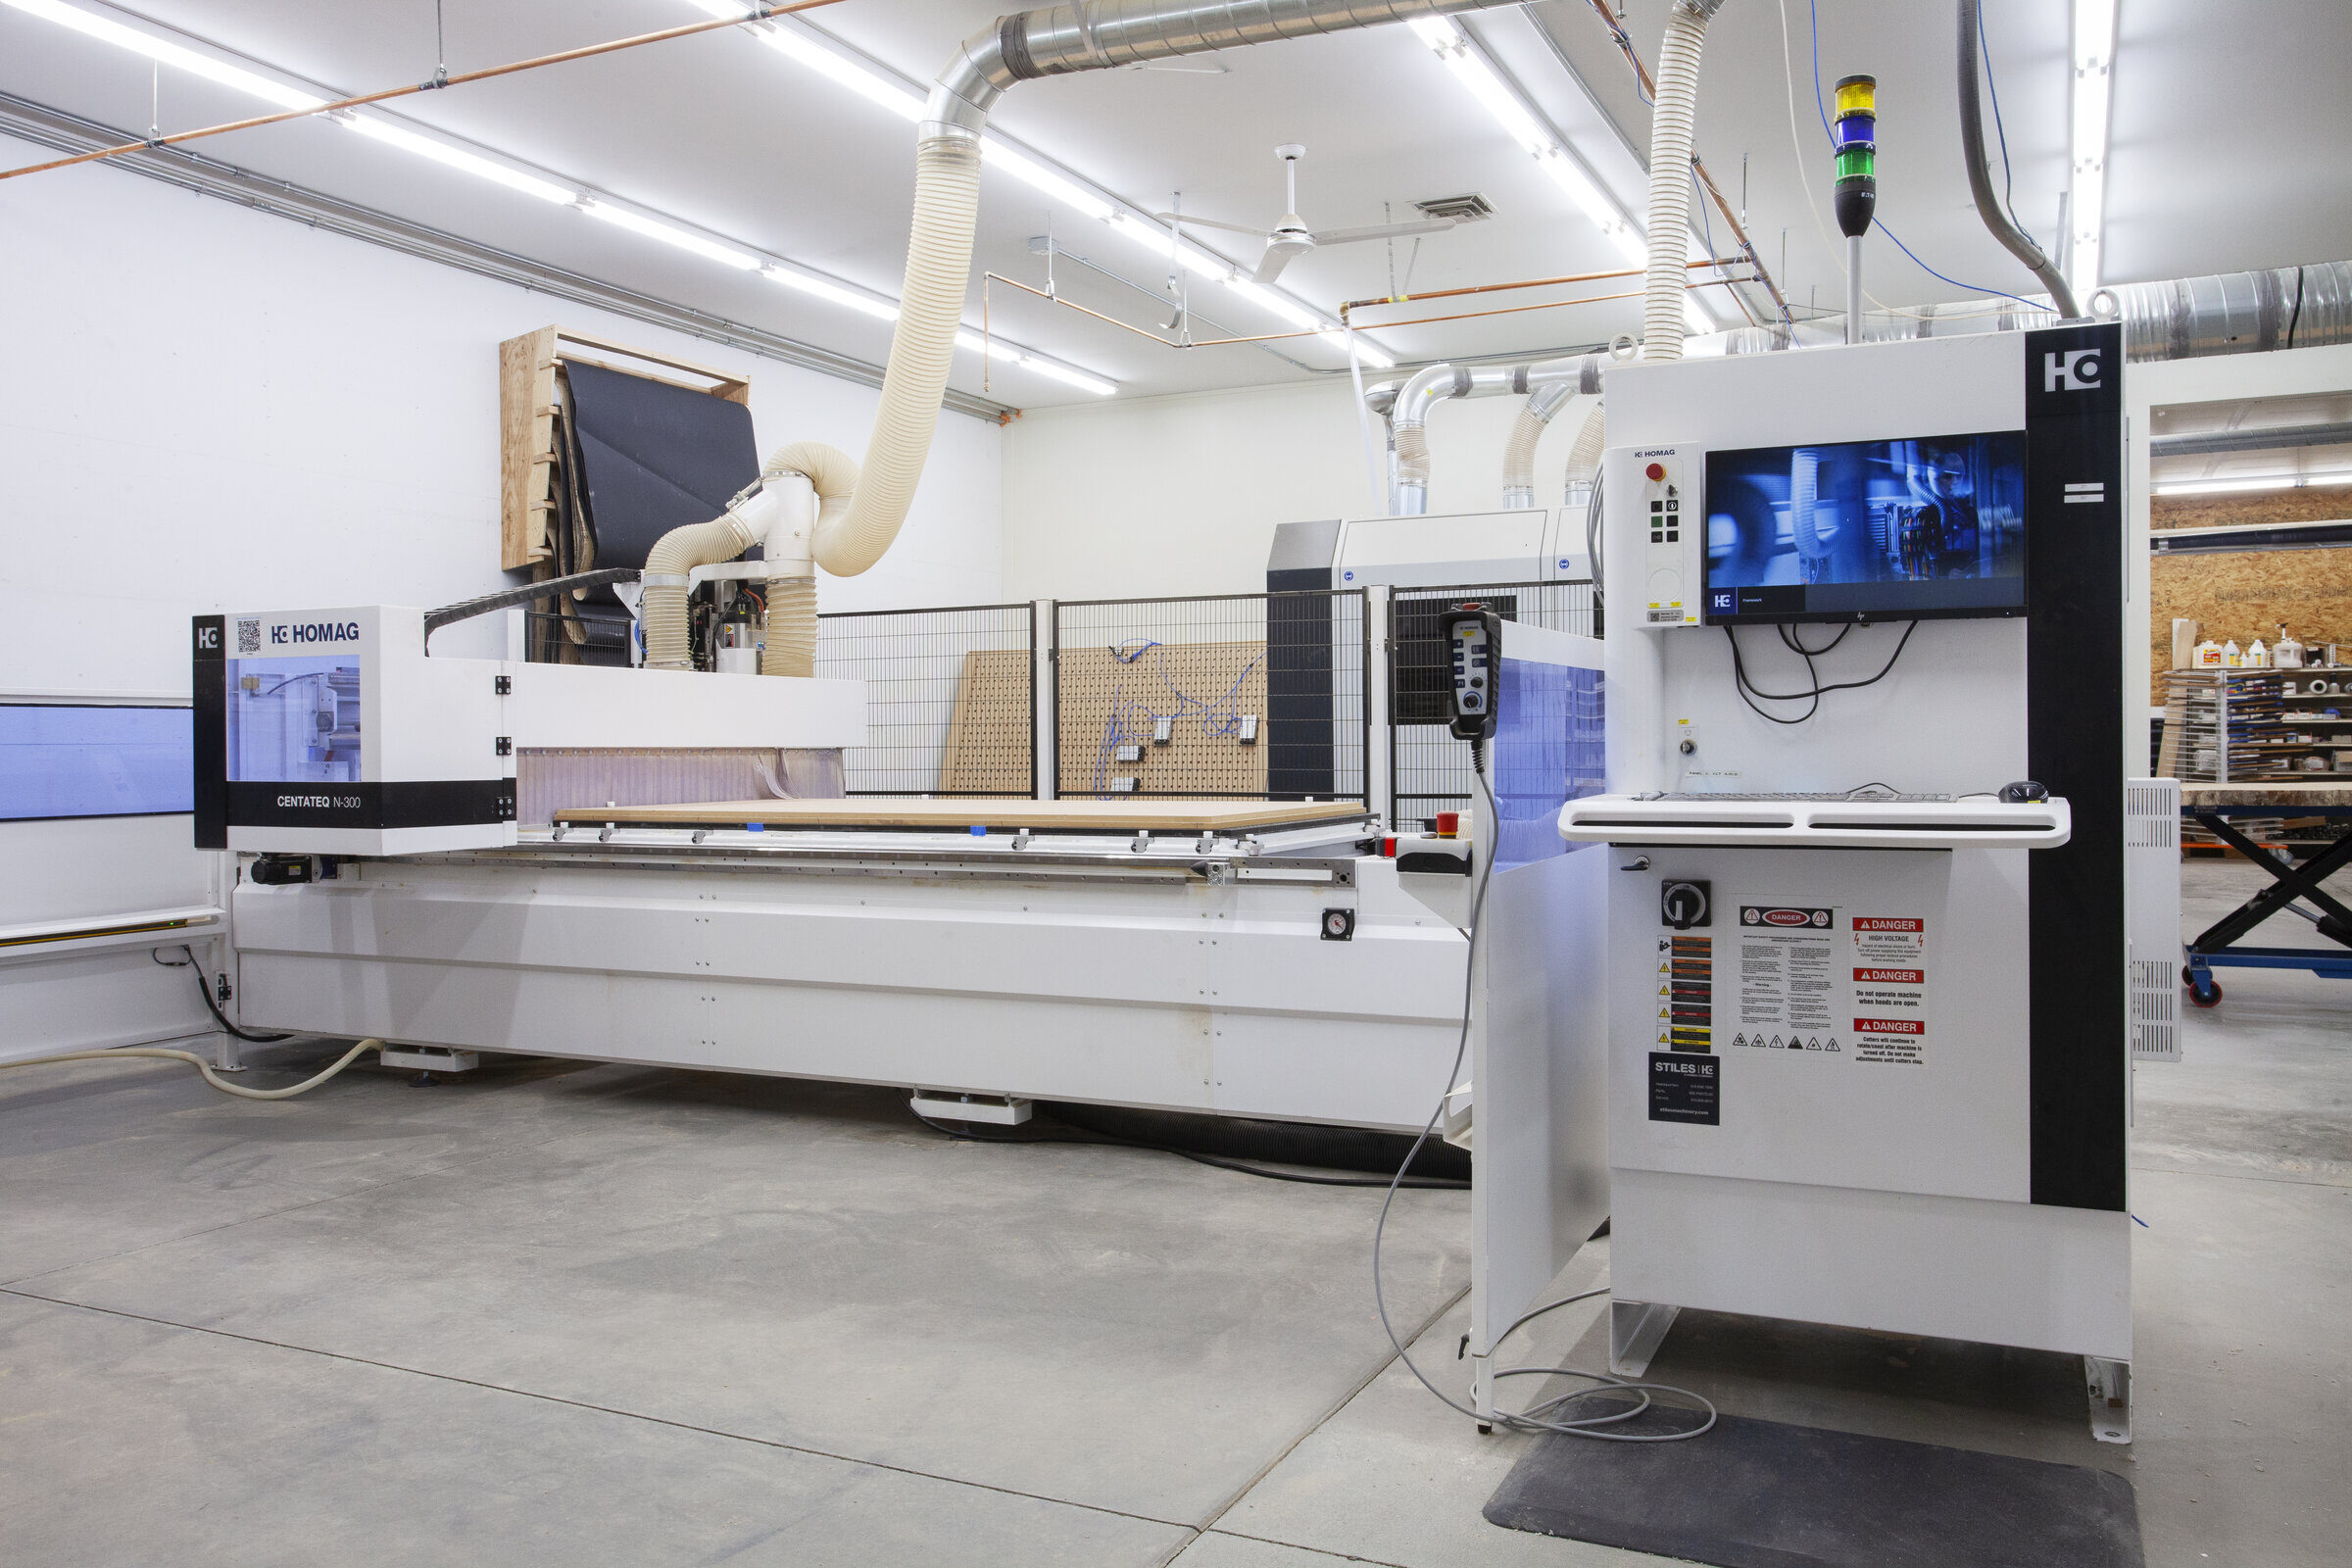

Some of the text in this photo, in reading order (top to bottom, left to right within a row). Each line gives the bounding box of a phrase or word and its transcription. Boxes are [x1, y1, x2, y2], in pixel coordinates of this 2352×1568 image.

[292, 622, 360, 643] HOMAG
[277, 796, 361, 808] CENTATEQ N-300
[1873, 920, 1915, 930] DANGER
[1873, 971, 1916, 981] DANGER
[1874, 1021, 1917, 1032] DANGER
[1655, 1061, 1695, 1073] STILES
